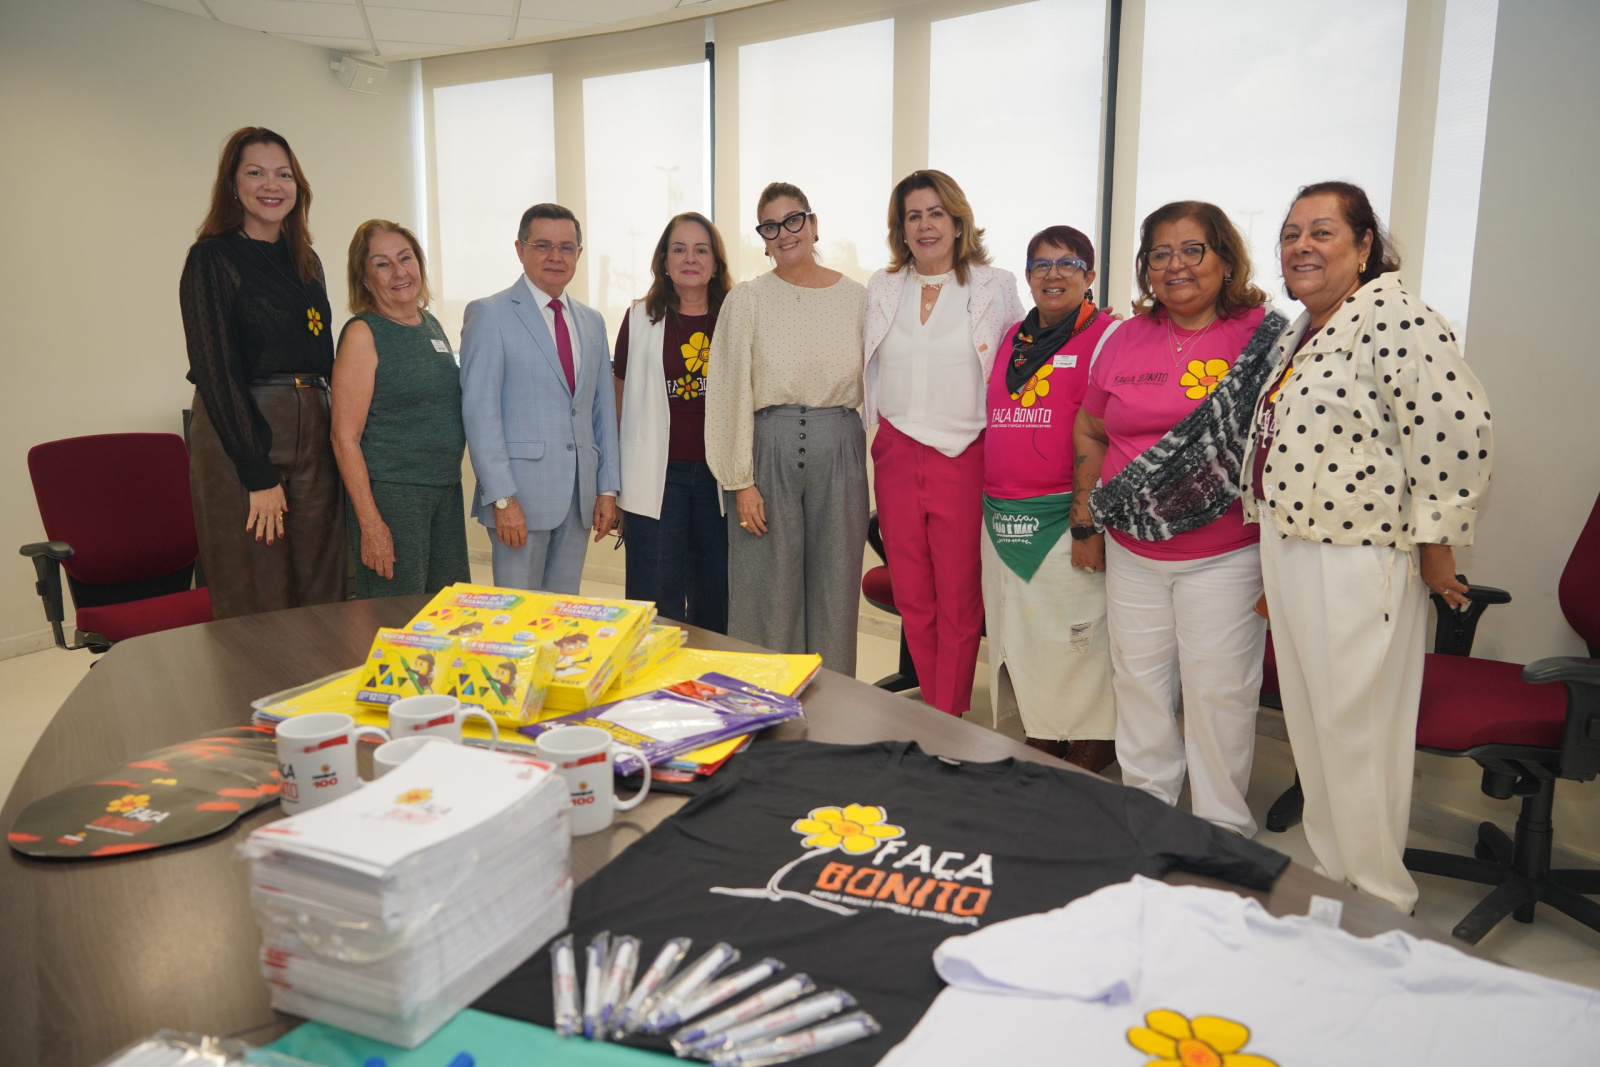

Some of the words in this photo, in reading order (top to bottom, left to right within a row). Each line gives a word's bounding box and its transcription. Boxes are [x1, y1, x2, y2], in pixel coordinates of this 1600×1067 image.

[1137, 372, 1169, 383] BONITO
[991, 408, 1011, 423] FAÇA
[1013, 407, 1052, 423] BONITO
[313, 777, 338, 789] 100
[571, 795, 595, 806] 100
[872, 840, 994, 885] FAÇA
[815, 861, 993, 917] BONITO
